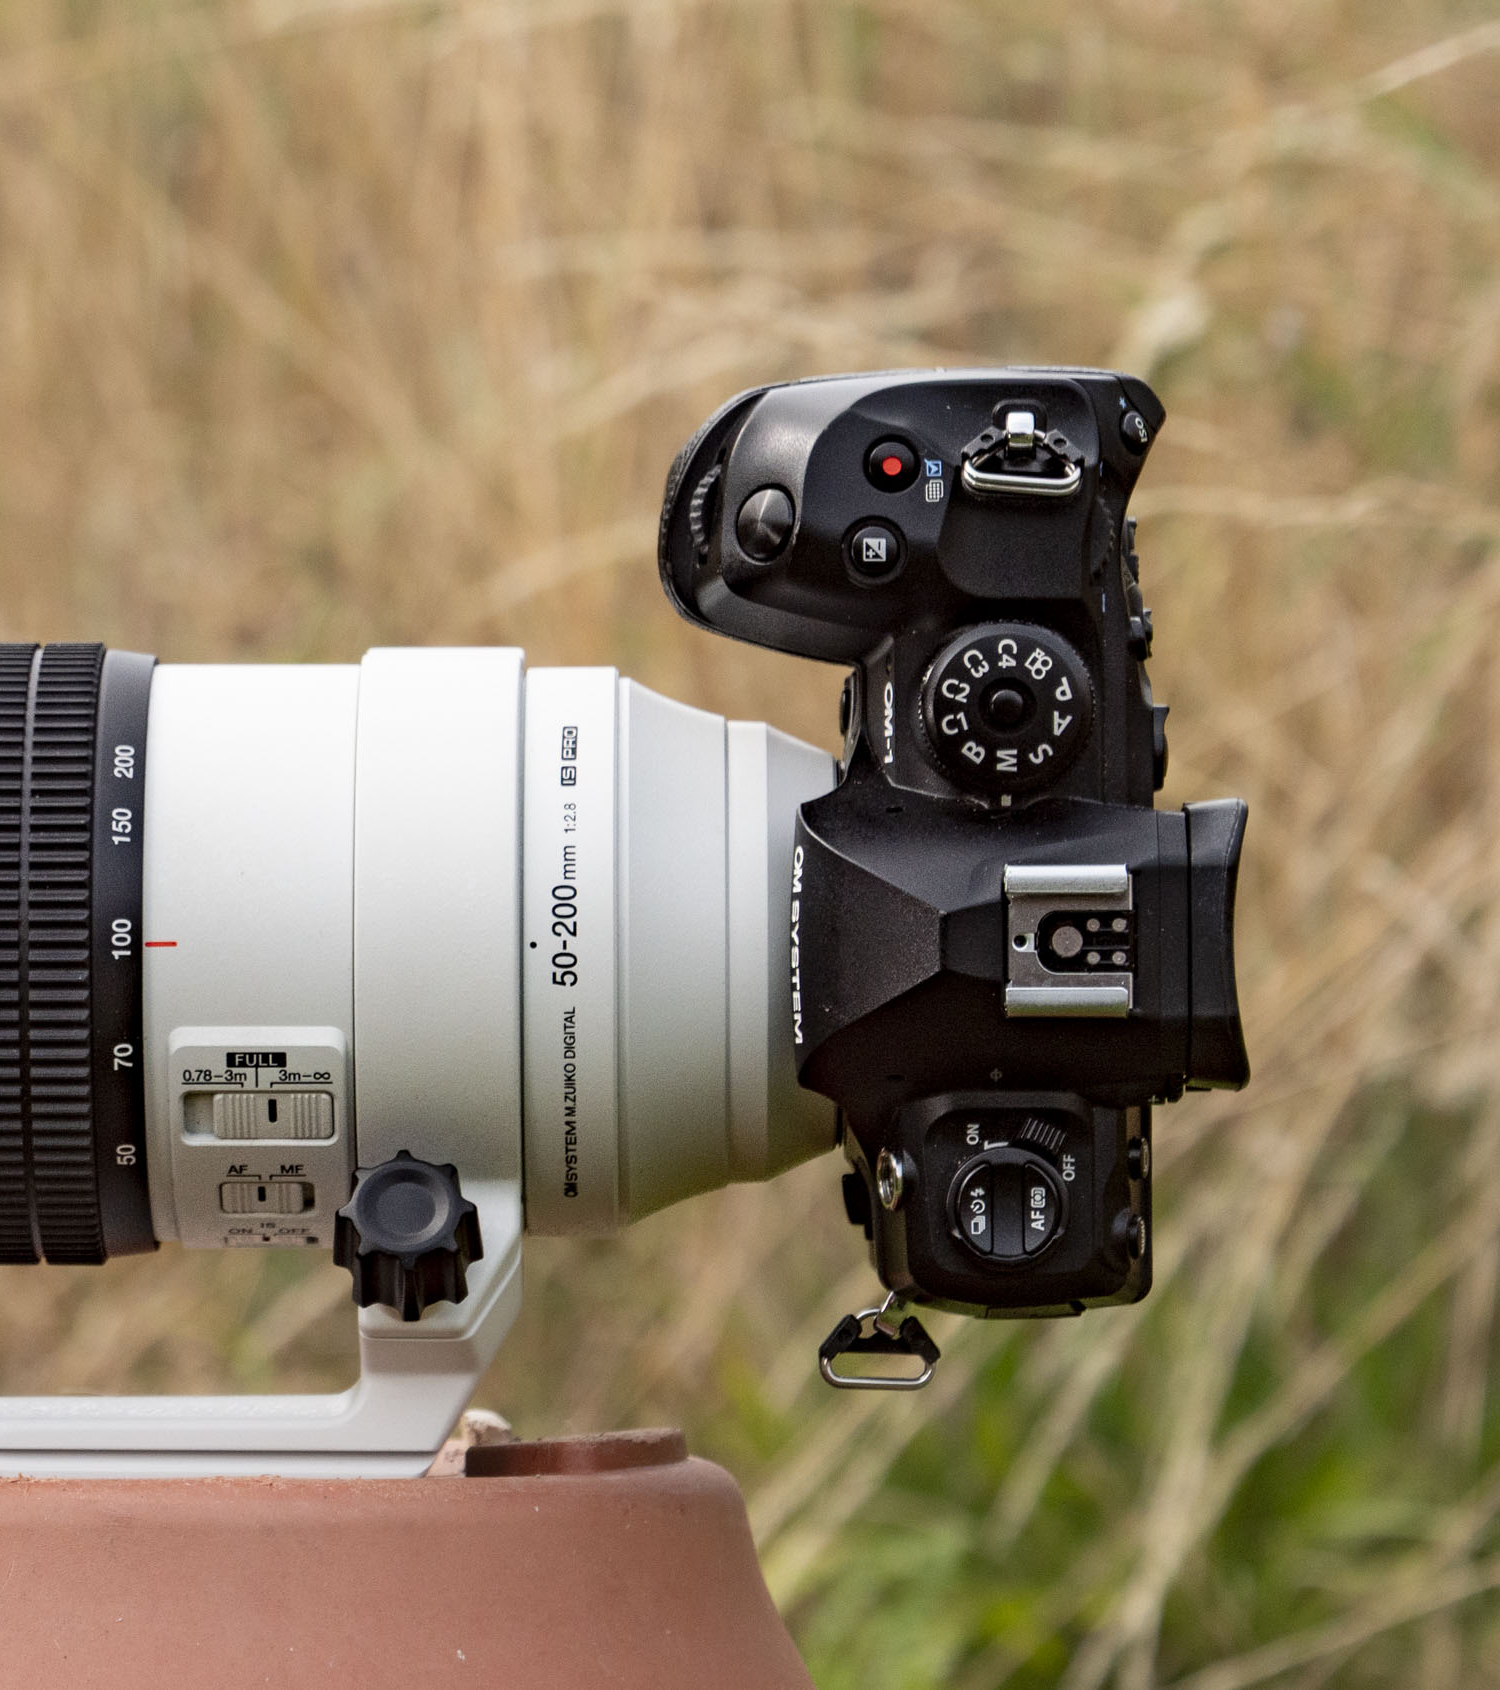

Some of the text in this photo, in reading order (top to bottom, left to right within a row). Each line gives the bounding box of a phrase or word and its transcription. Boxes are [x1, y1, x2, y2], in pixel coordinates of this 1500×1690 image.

[1135, 417, 1148, 443] ISO
[963, 650, 990, 678] C3
[998, 639, 1017, 668] C4
[942, 678, 970, 702] C2
[1055, 676, 1073, 701] P
[884, 681, 894, 764] OM-1
[941, 712, 969, 735] C1
[1053, 710, 1072, 736] A
[562, 727, 577, 760] PRO
[961, 740, 986, 765] B
[1028, 743, 1054, 764] S
[114, 744, 135, 779] 200
[997, 749, 1018, 772] M
[562, 766, 576, 785] IS
[111, 808, 132, 845] 150
[563, 803, 577, 834] 1:2.8
[111, 918, 132, 960] 100
[791, 845, 804, 1045] OM SYSTEM
[564, 1006, 576, 1059] DIGITAL
[113, 1043, 133, 1071] 70
[235, 1053, 279, 1067] FULL
[182, 1069, 247, 1082] 0.78-3m
[564, 1063, 576, 1117] M.ZUIKO
[966, 1123, 980, 1145] ON
[116, 1144, 136, 1166] 50
[564, 1120, 578, 1181] SYSTEM
[228, 1164, 248, 1174] AF
[280, 1164, 305, 1174] MF
[1062, 1154, 1076, 1181] OFF
[1031, 1210, 1045, 1231] AF
